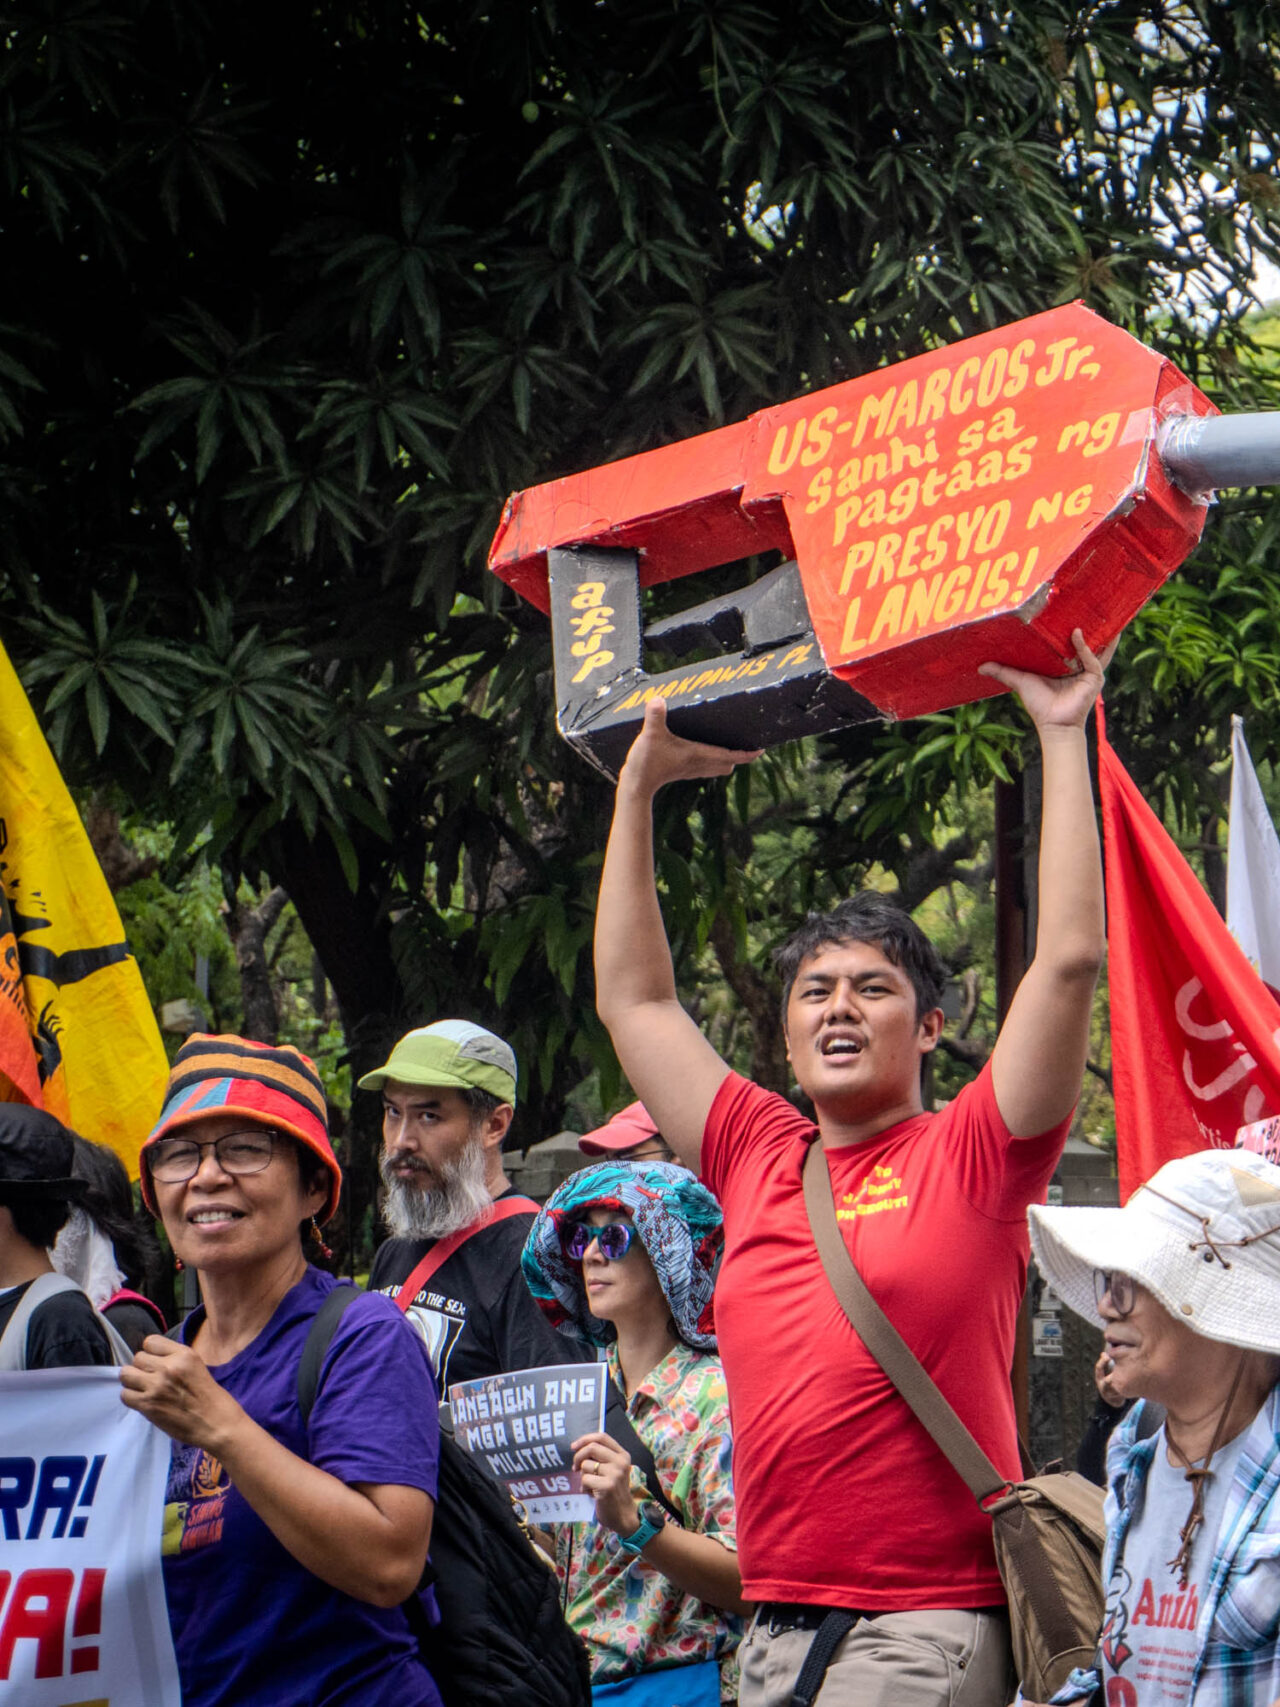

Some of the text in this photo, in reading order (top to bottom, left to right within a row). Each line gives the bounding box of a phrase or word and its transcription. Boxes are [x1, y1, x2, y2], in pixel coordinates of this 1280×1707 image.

[767, 339, 1036, 476] US-MARCOS
[806, 407, 1025, 514] sanhi sa
[832, 411, 1121, 547] pagtaas ng
[838, 484, 1093, 596] PRESYO NG
[839, 546, 1039, 655] LANGIS!
[426, 1291, 446, 1308] THE
[466, 1410, 566, 1452] MGA BASE
[544, 1378, 596, 1407] ANG
[486, 1443, 565, 1476] MILITAR
[508, 1475, 571, 1498] NG US
[0, 1568, 107, 1681] A!
